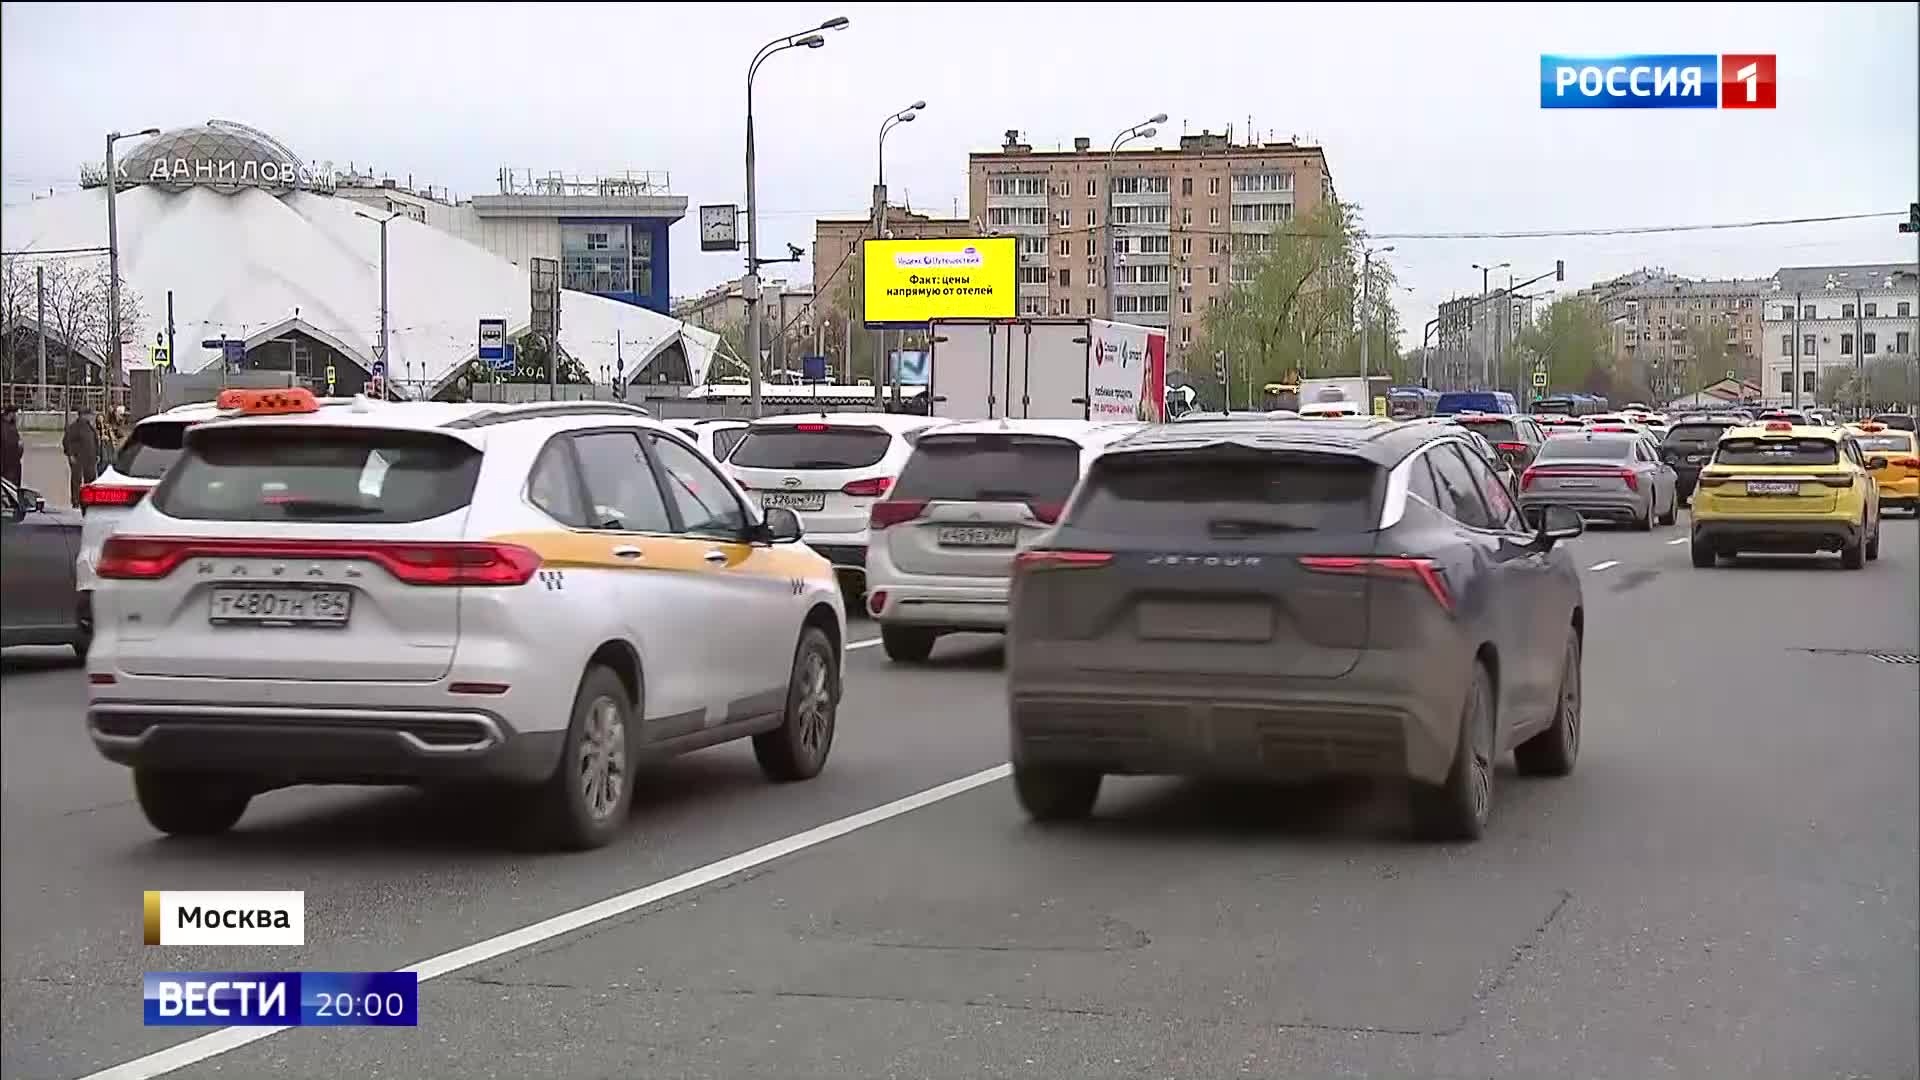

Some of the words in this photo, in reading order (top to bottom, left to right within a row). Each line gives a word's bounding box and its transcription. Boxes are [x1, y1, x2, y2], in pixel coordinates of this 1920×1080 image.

[909, 275, 941, 285] Факт:
[942, 276, 970, 286] цены
[886, 288, 941, 298] напрямую
[956, 285, 993, 296] отелей
